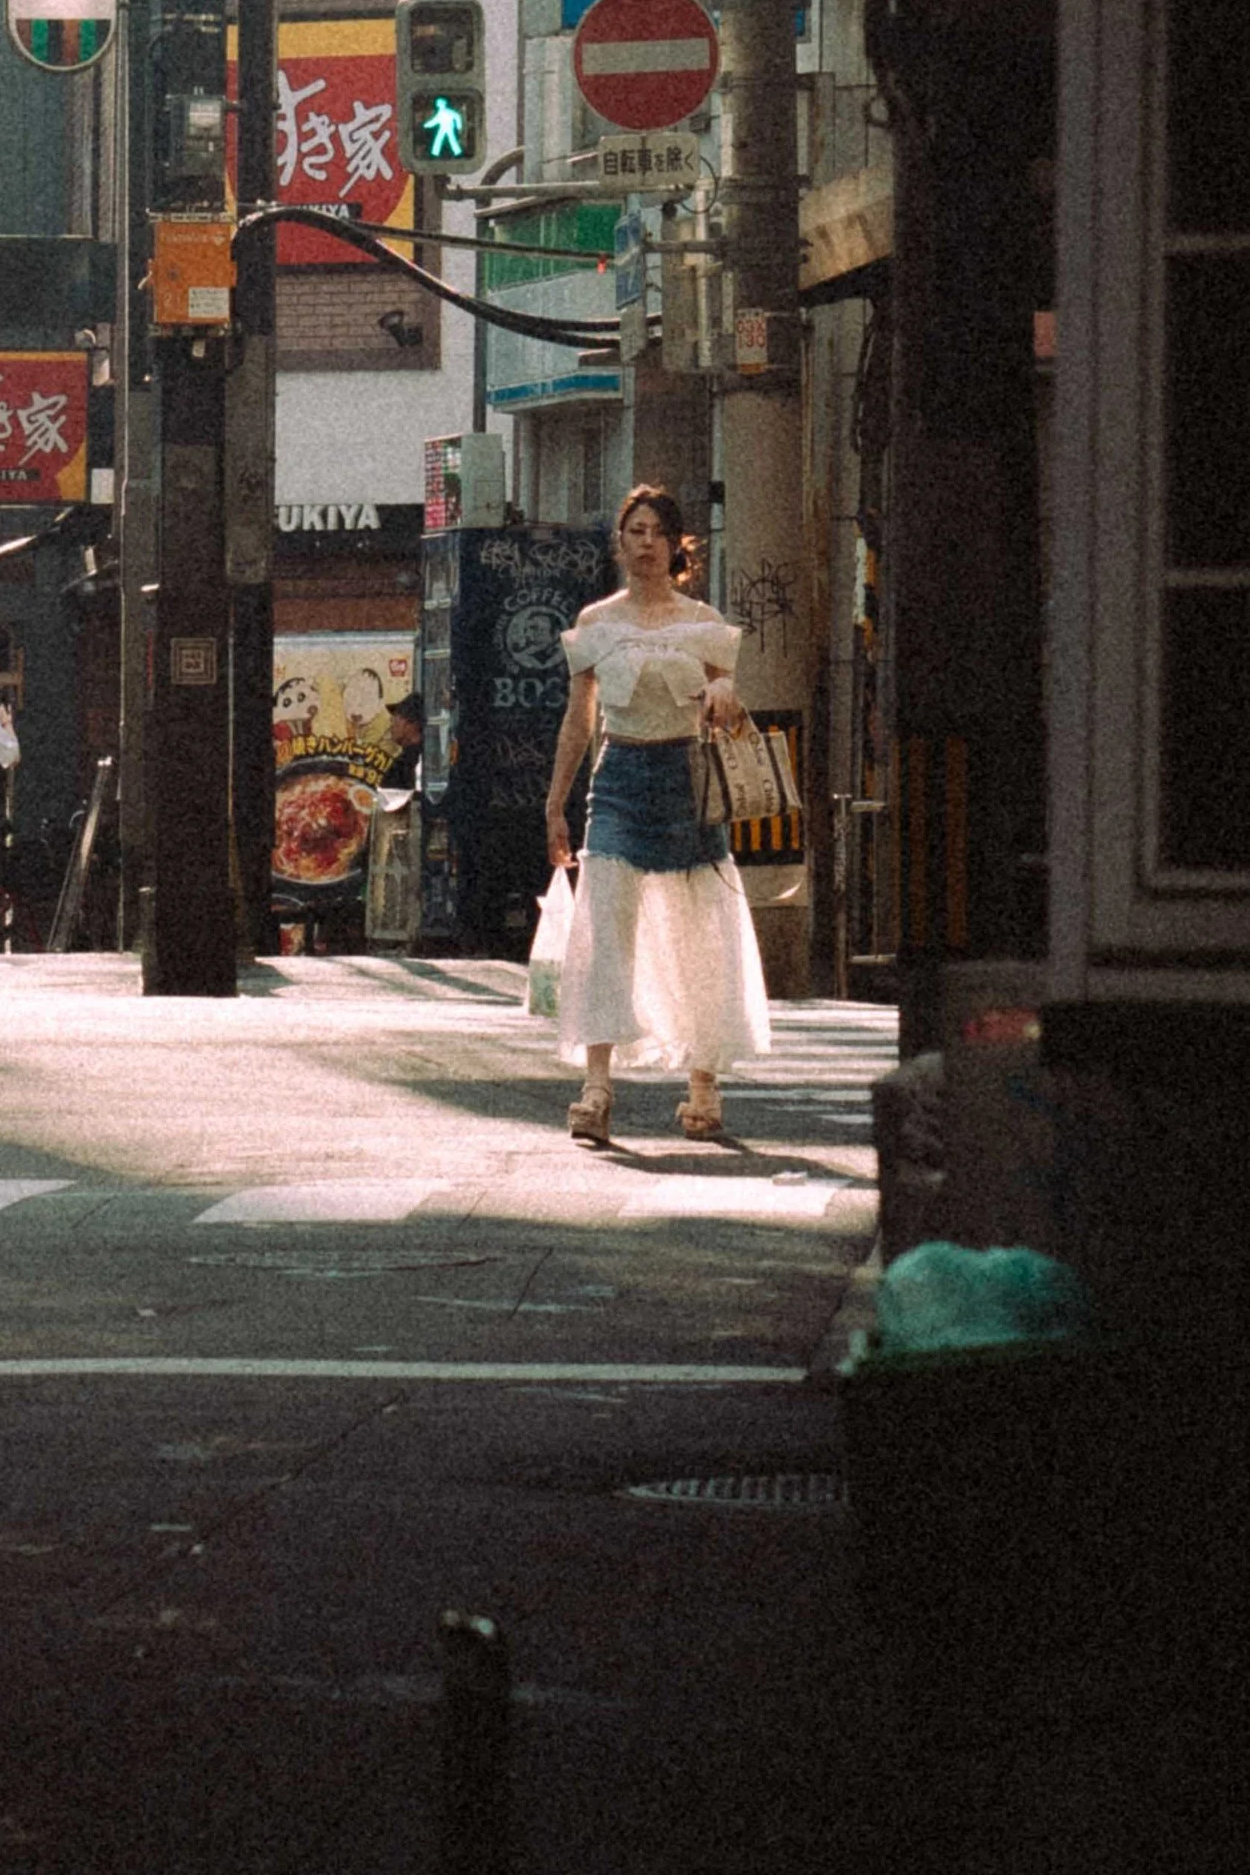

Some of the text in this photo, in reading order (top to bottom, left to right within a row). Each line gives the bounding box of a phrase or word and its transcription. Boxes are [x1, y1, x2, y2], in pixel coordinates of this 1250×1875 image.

[602, 146, 695, 176] 自転車を除く
[274, 503, 382, 532] UKIYA
